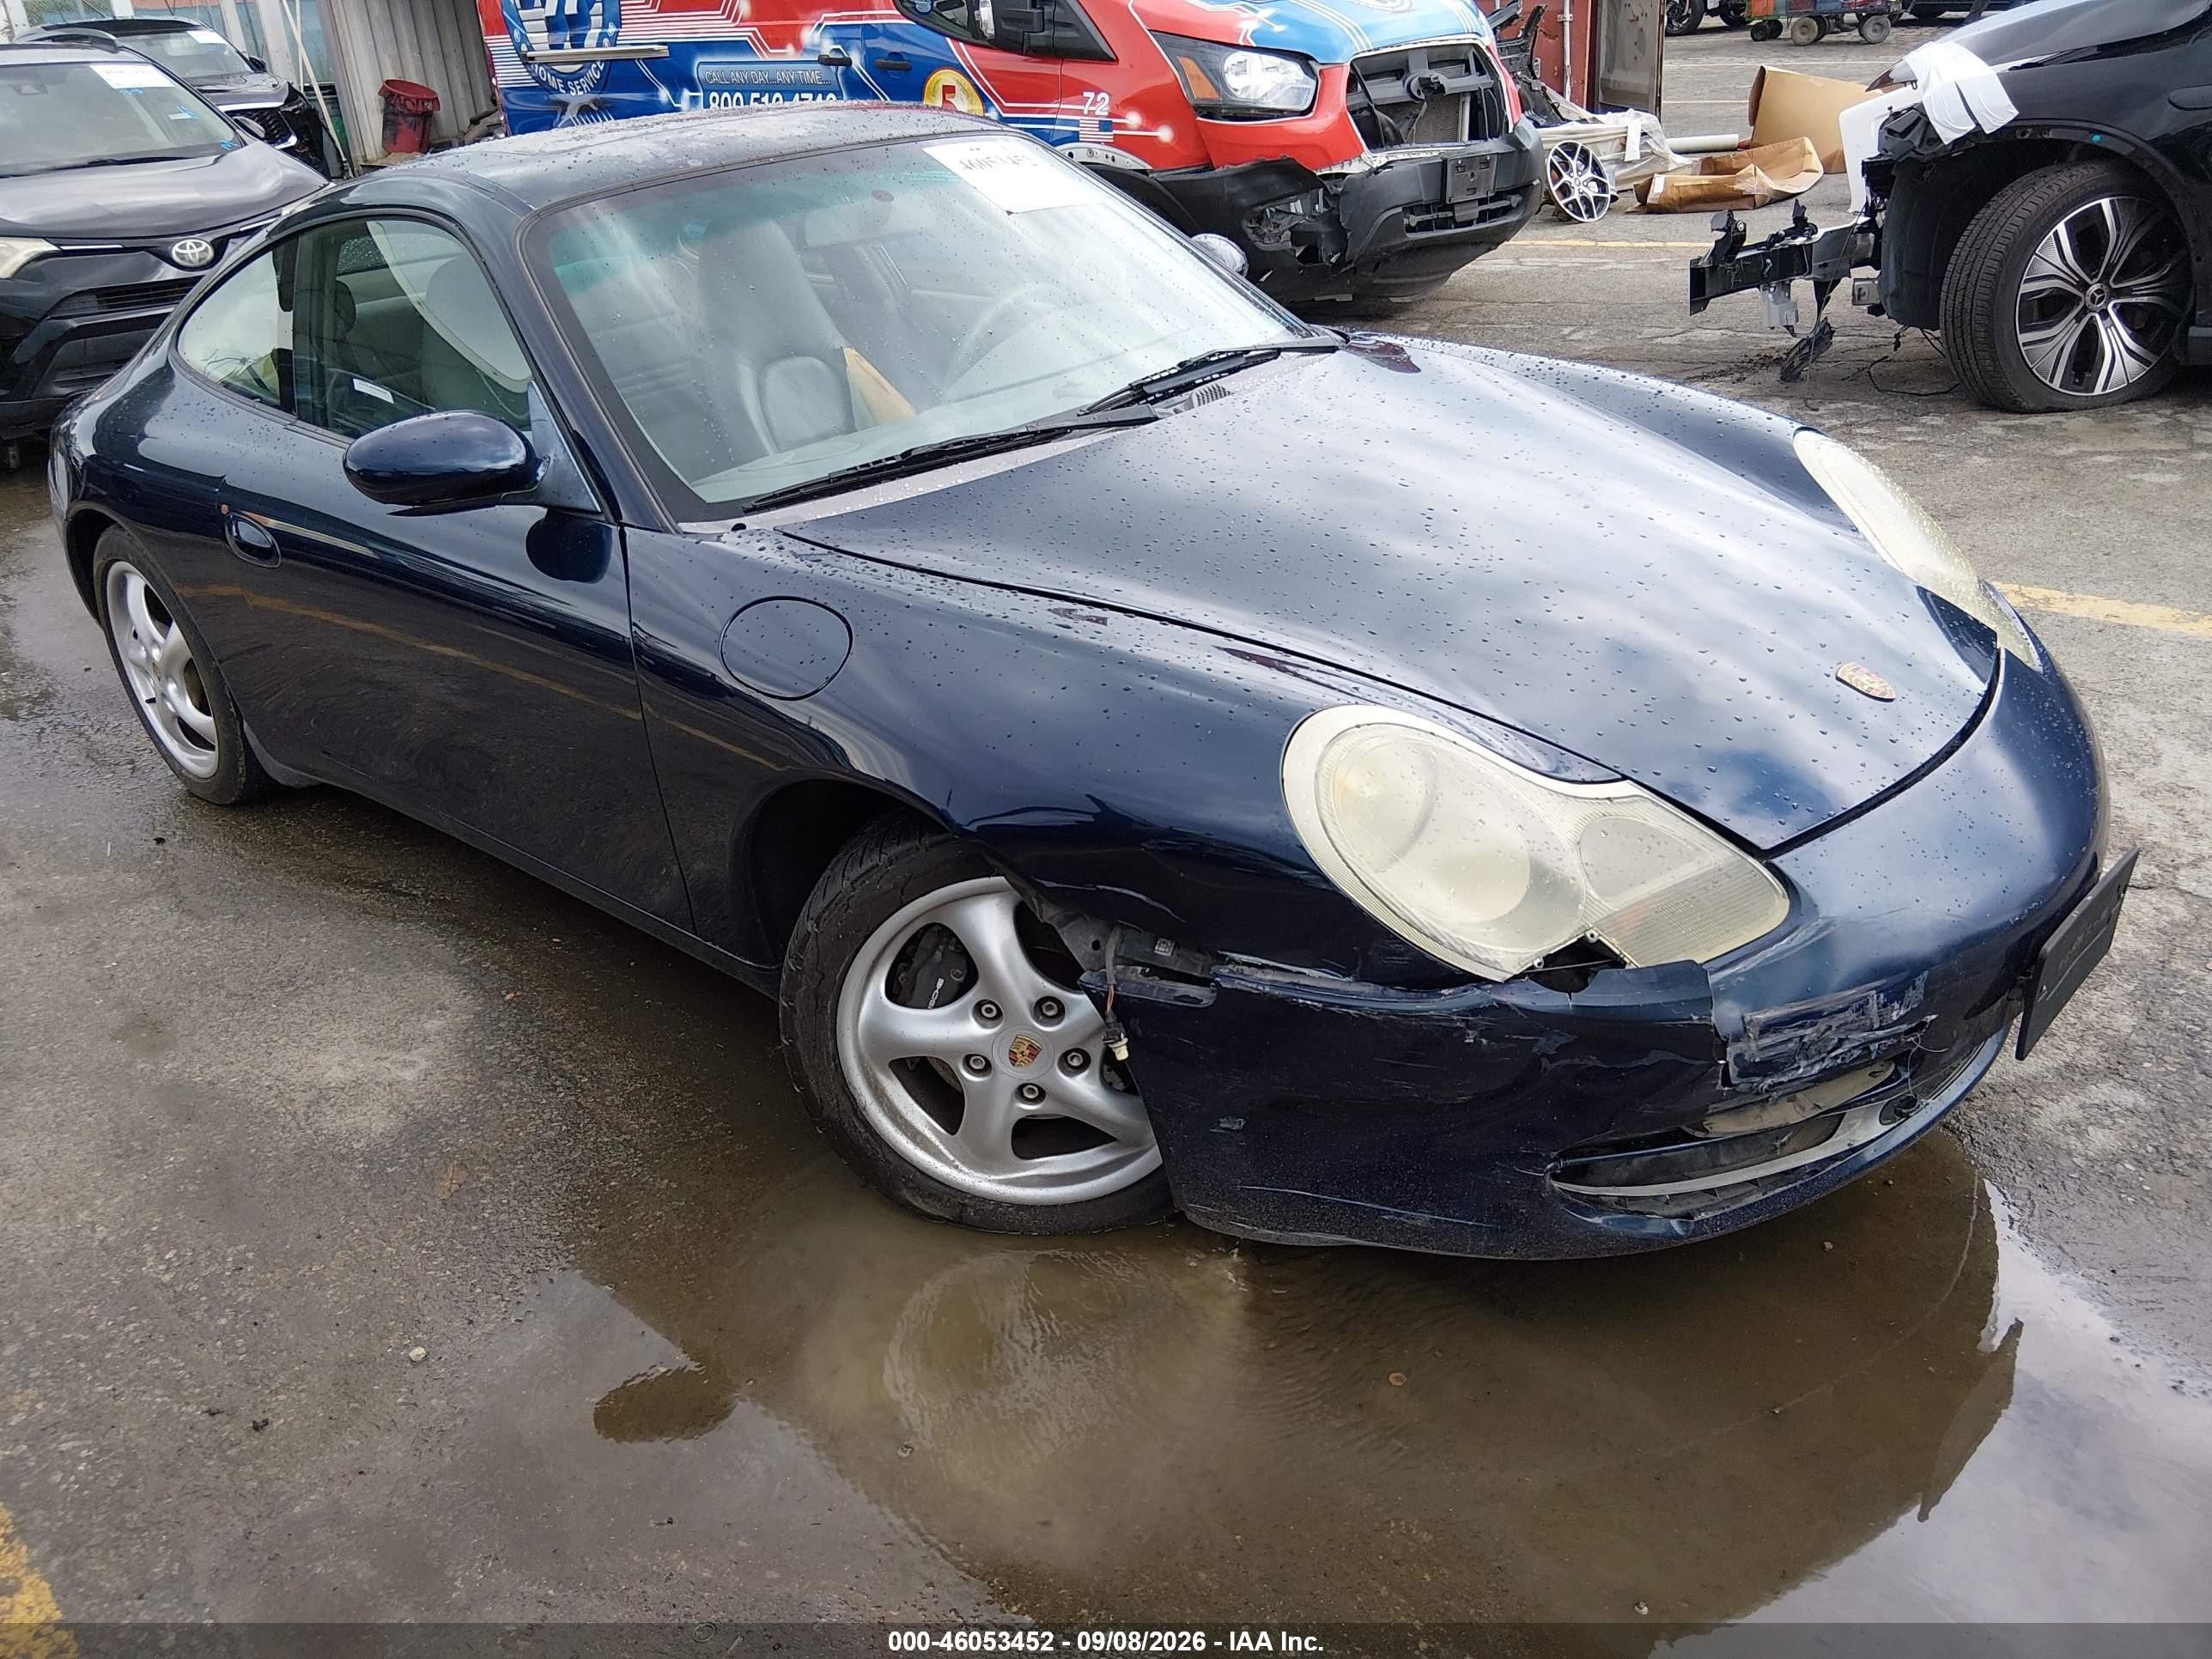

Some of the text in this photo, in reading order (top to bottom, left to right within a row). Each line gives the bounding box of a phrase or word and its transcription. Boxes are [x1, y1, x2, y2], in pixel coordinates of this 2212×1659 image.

[705, 70, 730, 84] CALL
[731, 70, 750, 84] ANY
[1082, 91, 1110, 116] 72
